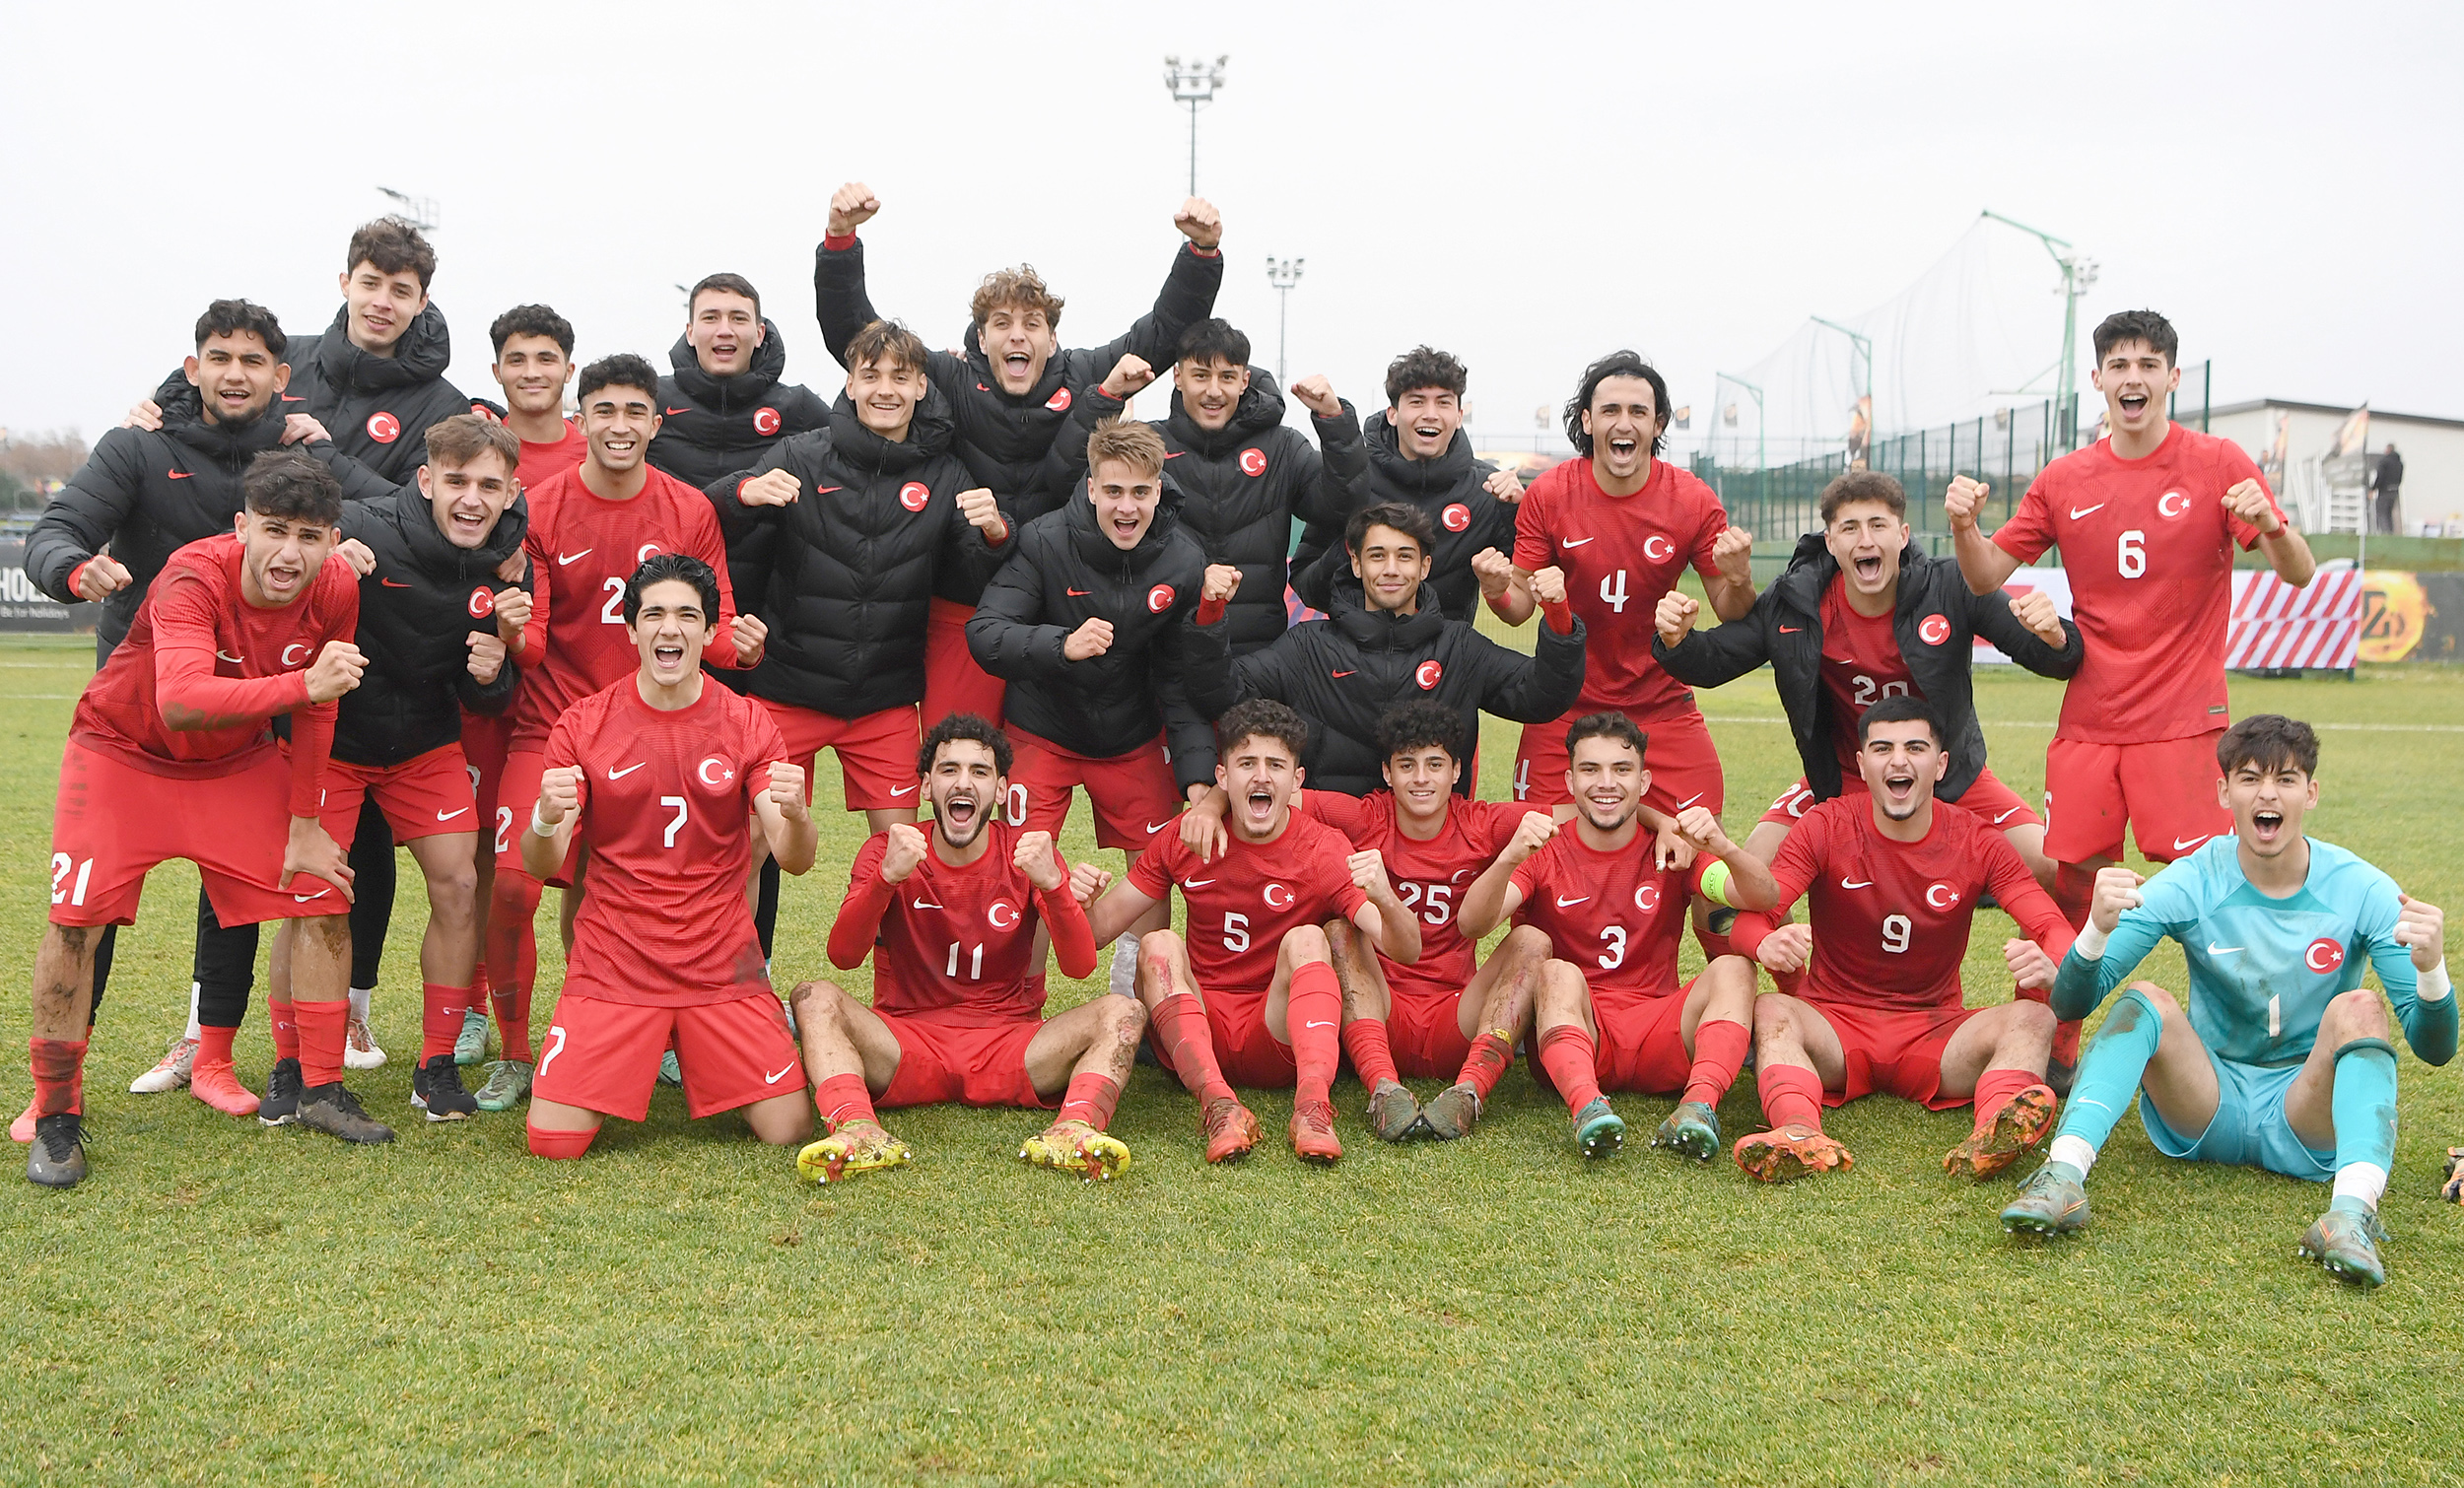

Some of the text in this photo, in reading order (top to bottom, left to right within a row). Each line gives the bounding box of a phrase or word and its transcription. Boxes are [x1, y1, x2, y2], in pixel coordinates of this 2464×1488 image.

[2118, 530, 2146, 578] 6
[1600, 570, 1630, 613] 4
[495, 806, 513, 854] 2
[660, 796, 688, 848] 7
[51, 852, 94, 906] 21
[1399, 881, 1452, 924] 25
[1223, 912, 1250, 953] 5
[1599, 926, 1626, 970] 3
[1882, 914, 1911, 953] 9
[946, 940, 984, 980] 11
[2269, 993, 2281, 1038] 1
[540, 1026, 567, 1076] 7
